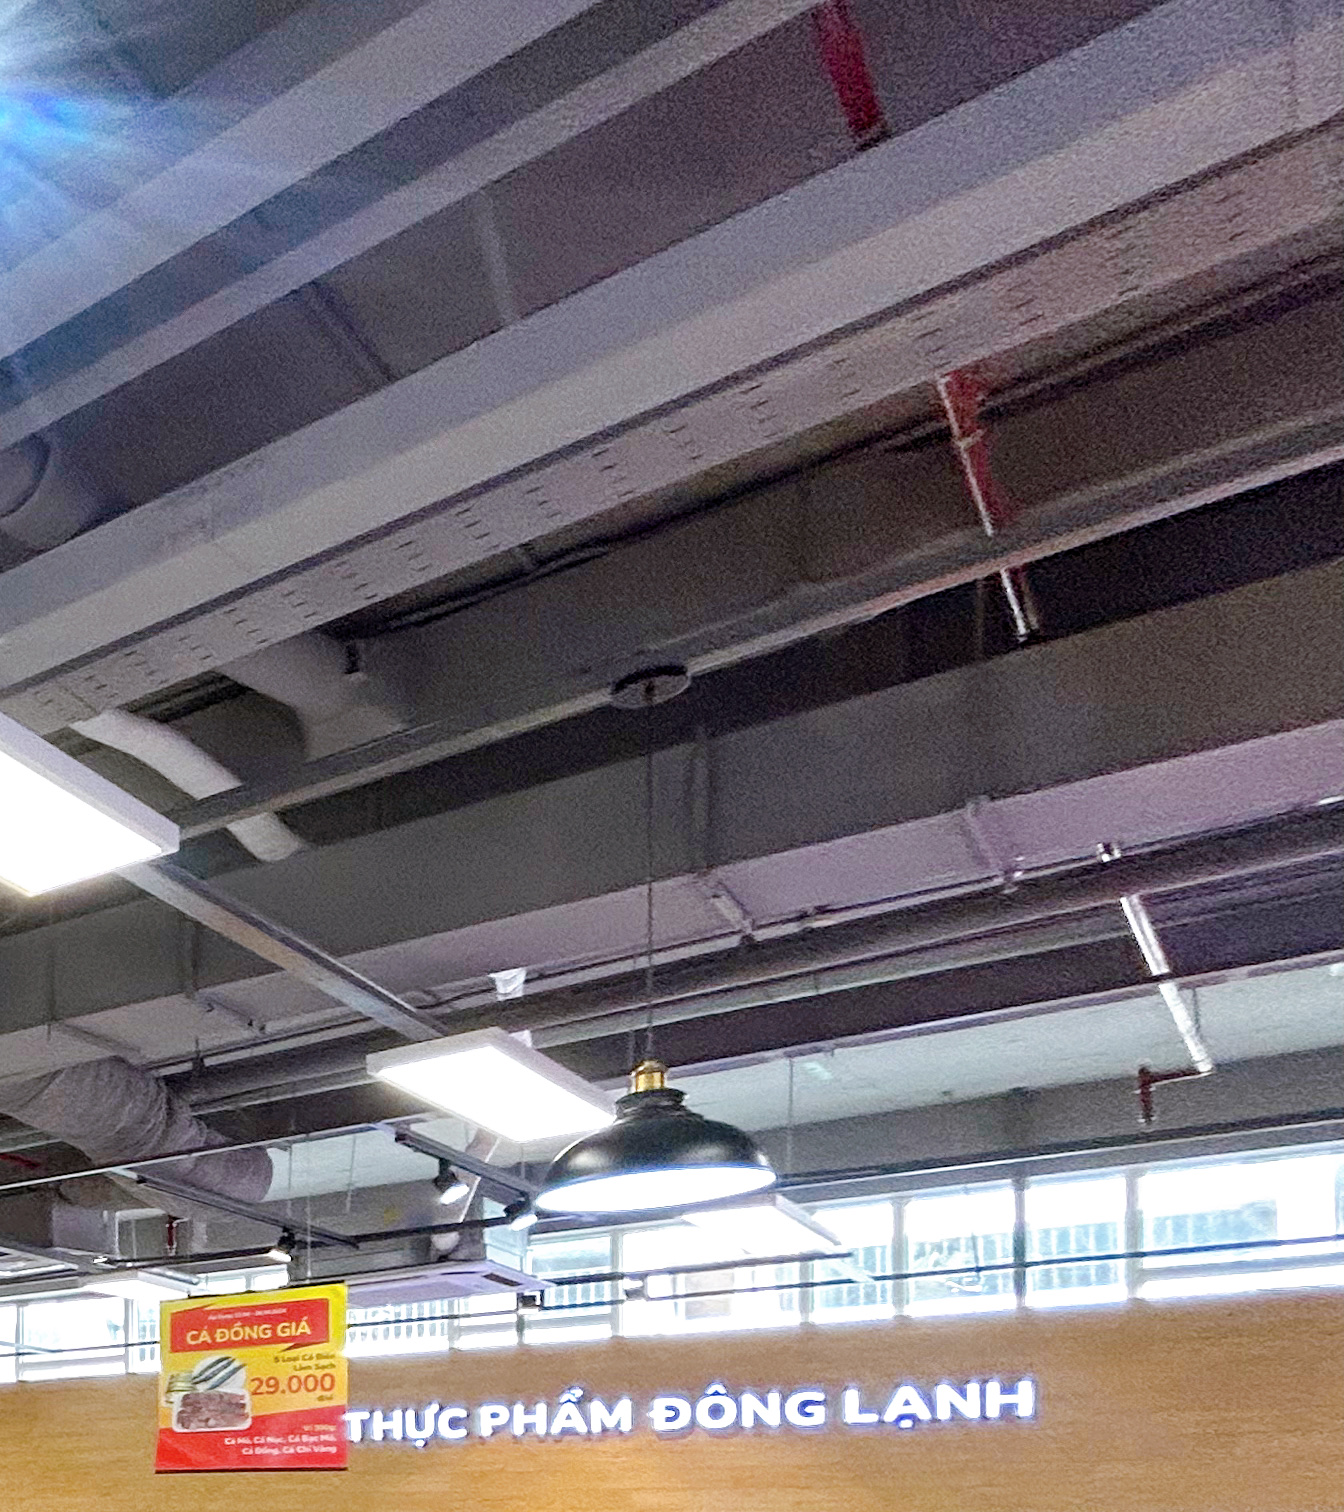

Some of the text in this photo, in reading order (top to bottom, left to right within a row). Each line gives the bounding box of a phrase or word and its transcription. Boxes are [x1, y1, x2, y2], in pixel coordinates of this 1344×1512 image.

[186, 1326, 211, 1345] CÁ
[277, 1316, 311, 1337] GIÁ
[250, 1373, 336, 1396] 29.000
[344, 1381, 1035, 1448] THỰC PHẨM ĐÔNG LẠNH
